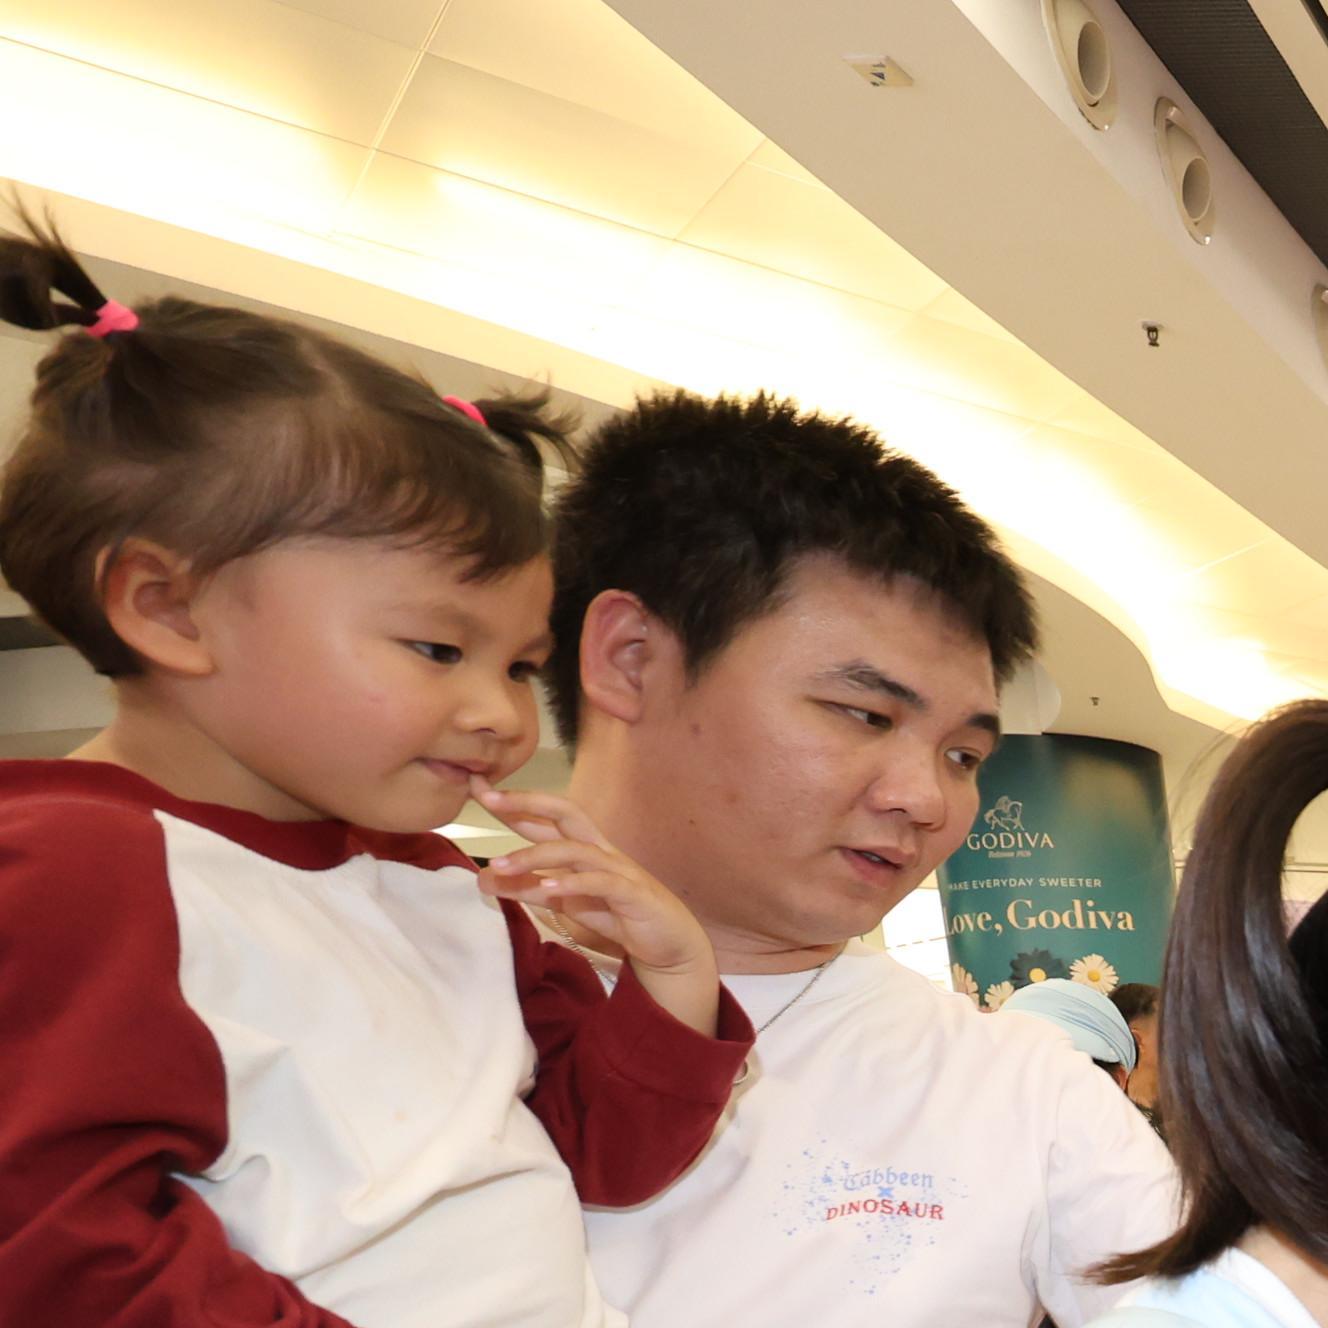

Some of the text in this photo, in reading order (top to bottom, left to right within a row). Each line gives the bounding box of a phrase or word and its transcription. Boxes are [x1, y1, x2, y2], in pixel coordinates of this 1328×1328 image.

[966, 832, 1055, 850] GODIVA
[972, 878, 1034, 889] EVERYDAY
[1039, 877, 1102, 888] SWEETER
[1006, 899, 1136, 931] Godiva
[826, 1199, 945, 1221] DINOSAUR
